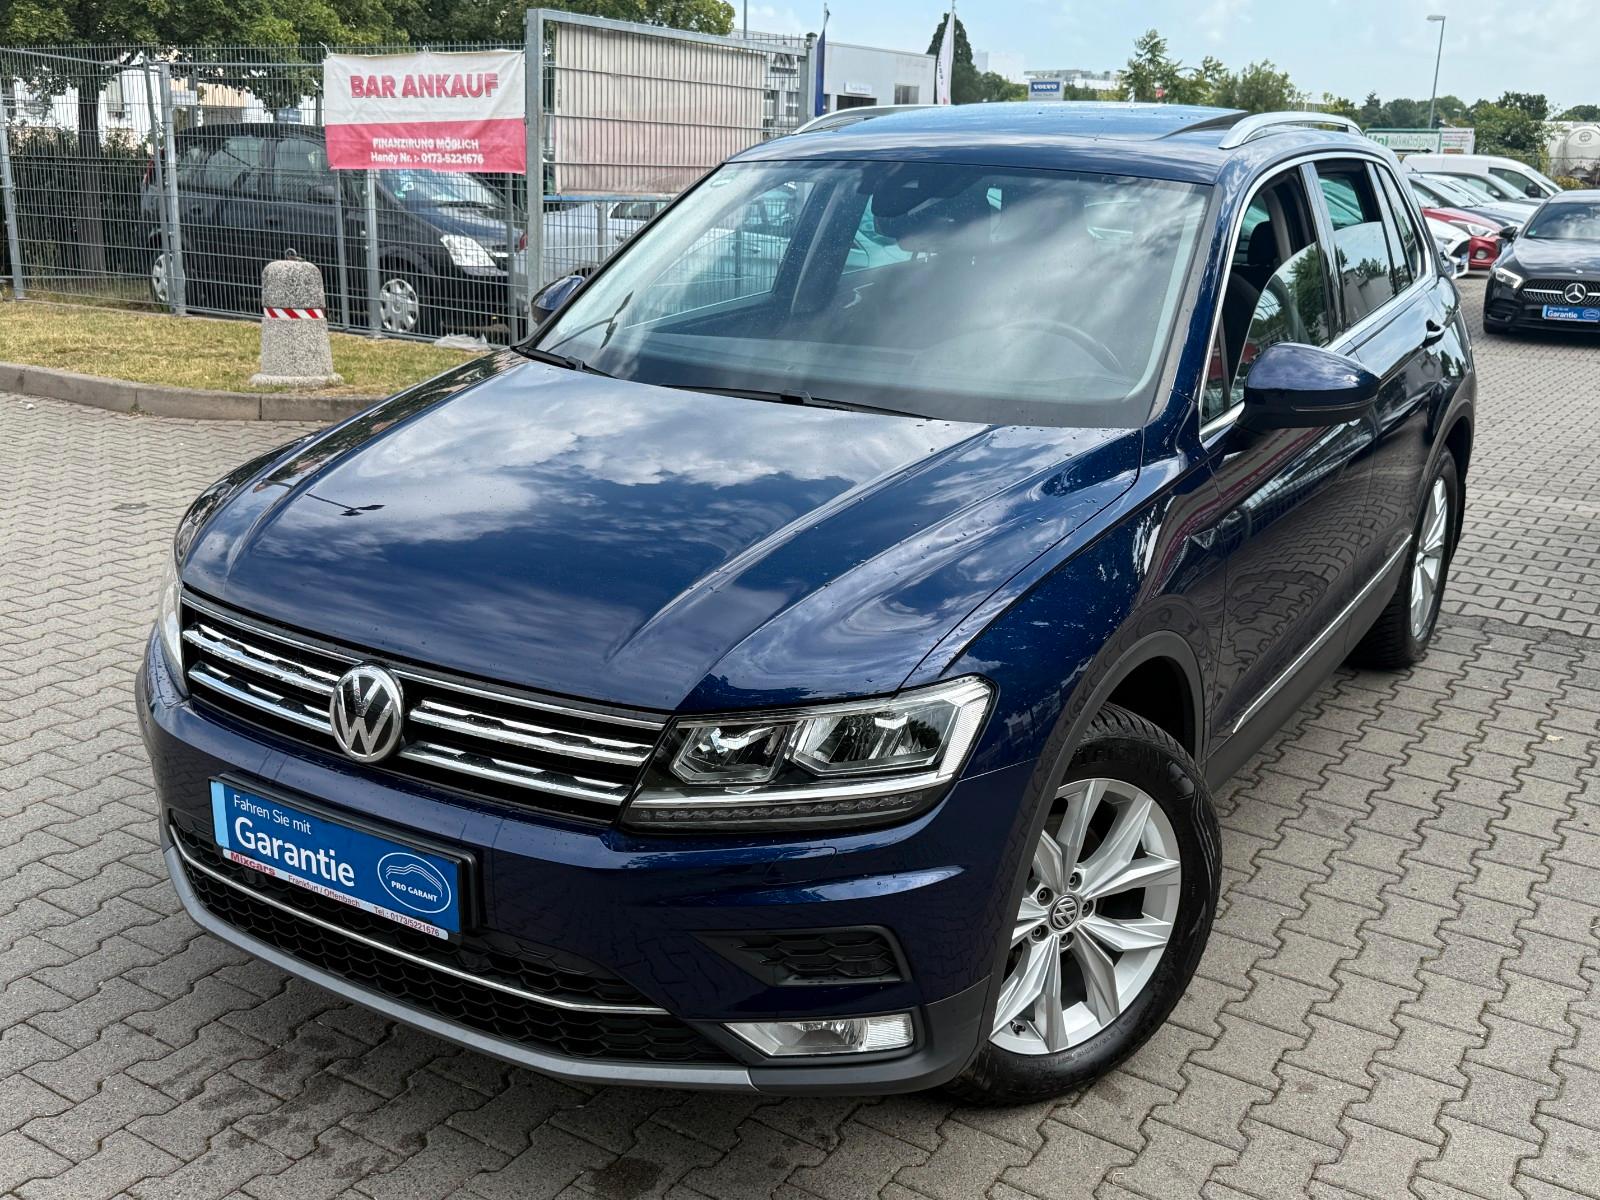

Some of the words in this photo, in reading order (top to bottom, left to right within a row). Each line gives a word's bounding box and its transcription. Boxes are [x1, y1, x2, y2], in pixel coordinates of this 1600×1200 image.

[351, 75, 397, 98] BAR
[402, 73, 499, 98] ANKAUF
[372, 137, 434, 149] FINANZIRUNG
[436, 137, 479, 150] MÖGLICH
[370, 152, 398, 165] Handy
[400, 152, 413, 163] Nr.
[421, 153, 484, 165] 0173-5221676
[1547, 310, 1578, 319] Garantie
[331, 667, 401, 761] VW
[233, 794, 270, 820] Fahren
[272, 809, 290, 827] Sie
[293, 819, 312, 835] mit
[234, 816, 355, 887] Garantie
[230, 852, 276, 877] Mixcars
[391, 880, 407, 892] PRO
[408, 886, 438, 903] GARANT
[323, 888, 361, 908] Offenbach
[390, 911, 440, 937] 0173/5221676
